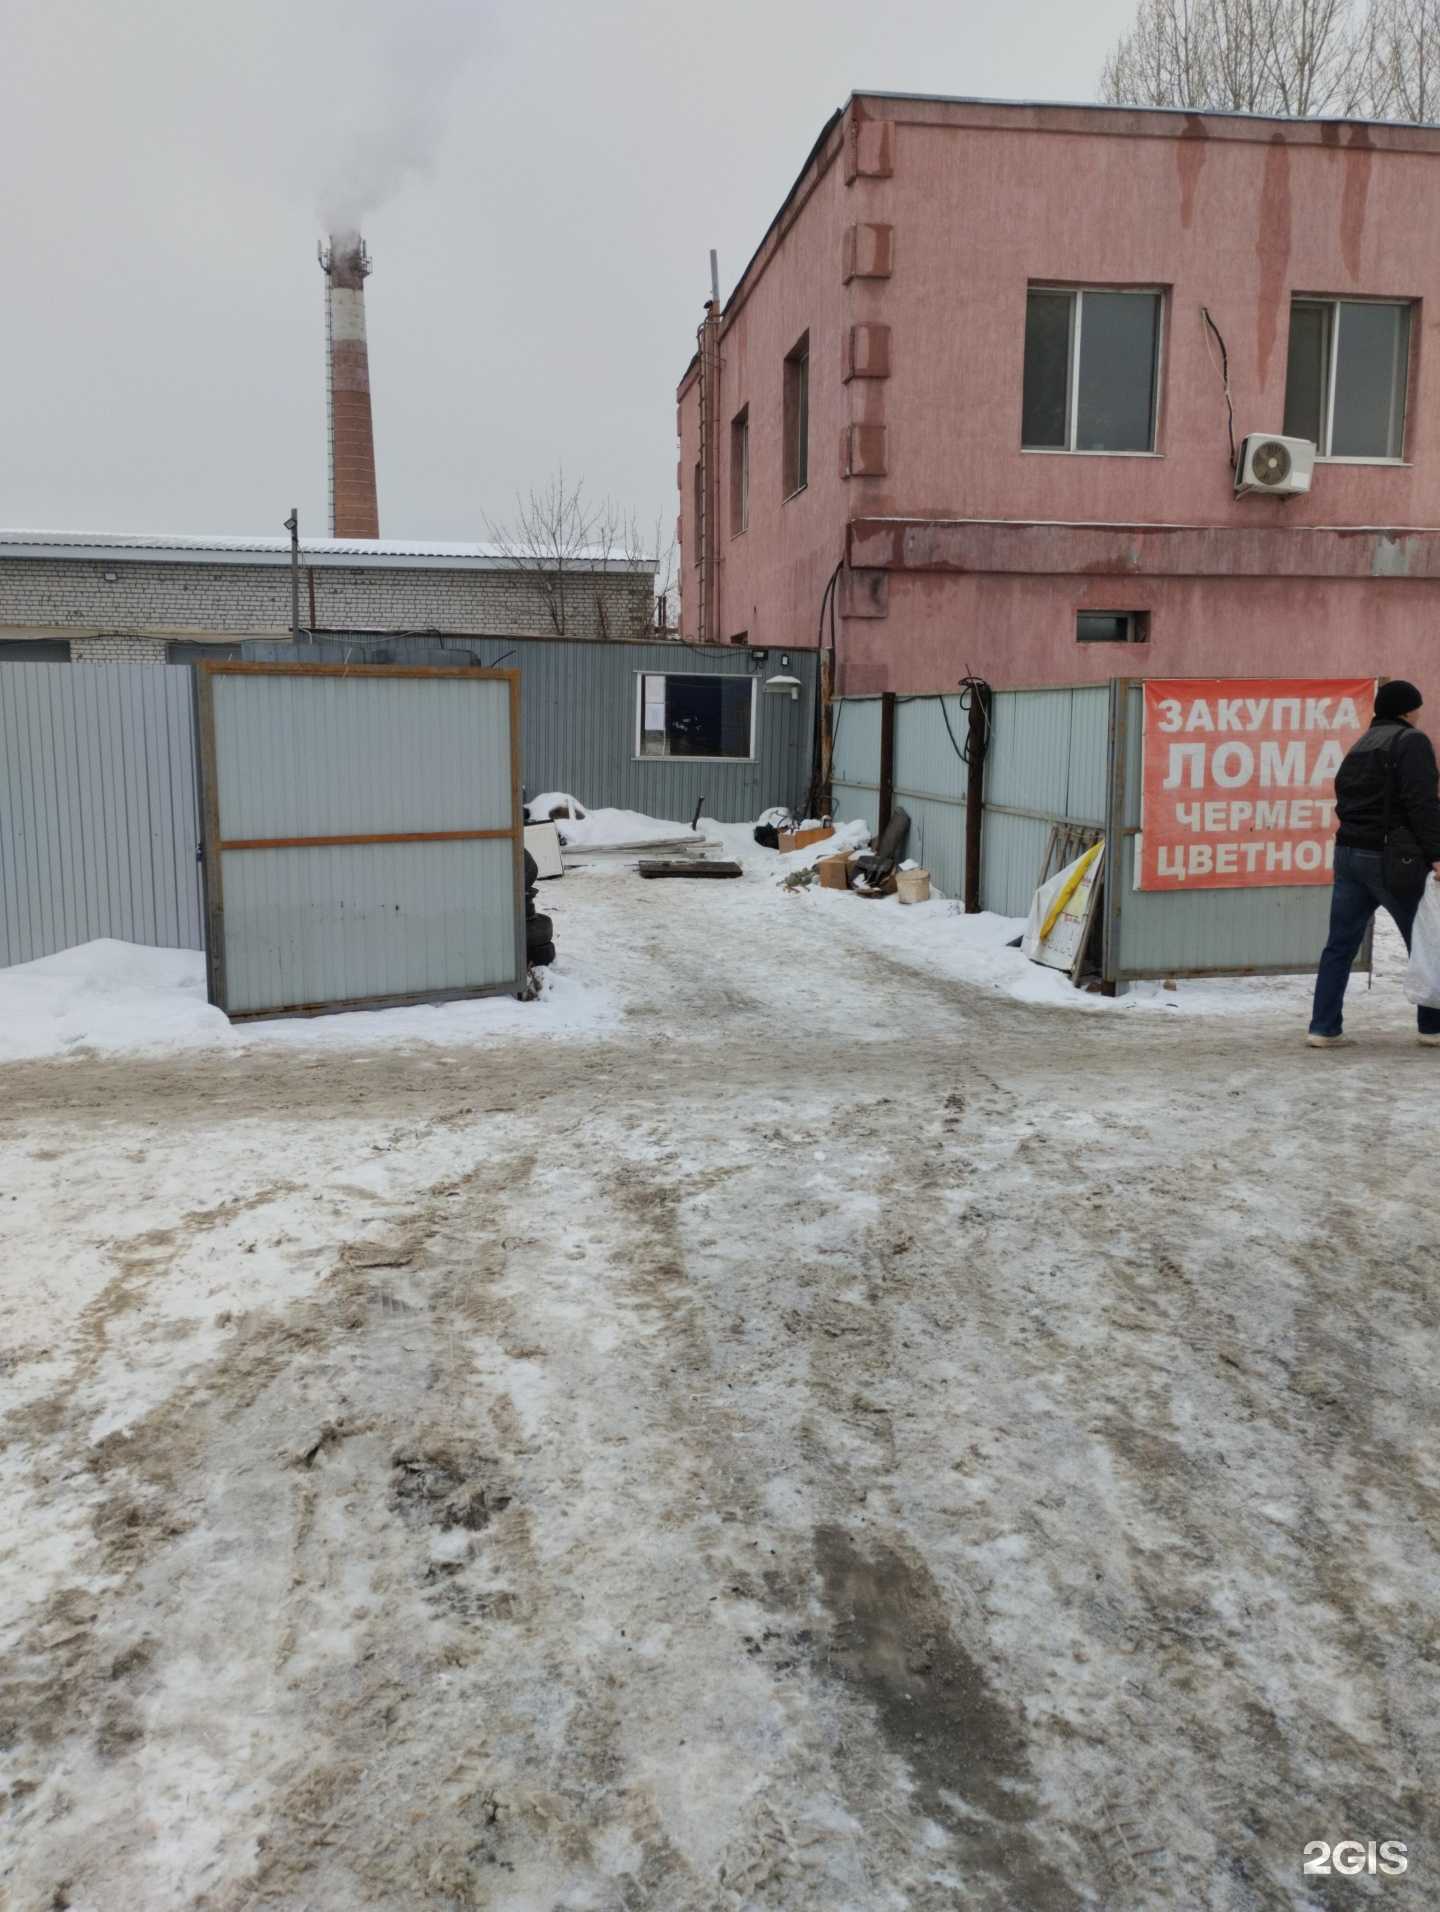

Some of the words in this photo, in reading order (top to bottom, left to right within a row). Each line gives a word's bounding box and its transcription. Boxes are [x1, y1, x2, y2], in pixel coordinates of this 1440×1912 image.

[1157, 697, 1361, 733] ЗАКУПКА
[1163, 740, 1347, 790] ЛОМА
[1175, 799, 1338, 833] ЧЕРМЕТ
